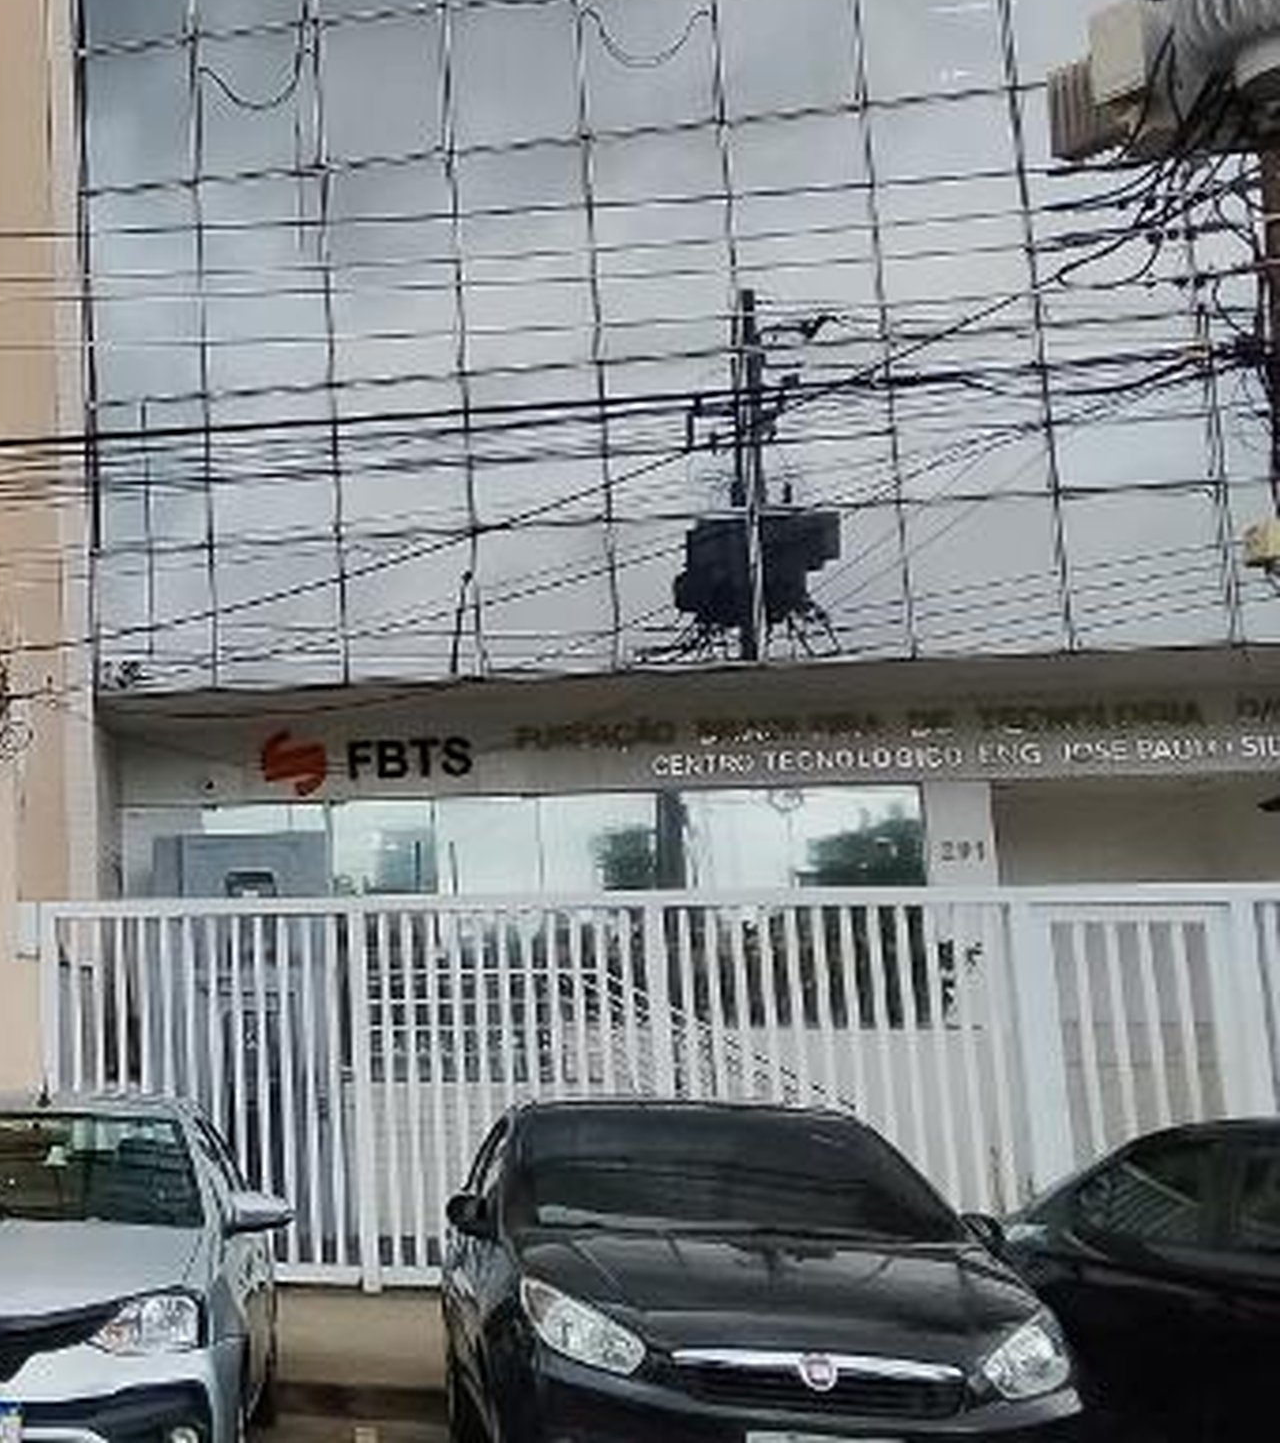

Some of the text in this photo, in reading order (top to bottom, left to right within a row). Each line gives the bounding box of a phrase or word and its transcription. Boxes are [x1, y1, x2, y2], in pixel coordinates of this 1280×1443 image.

[347, 736, 473, 779] FBTS
[651, 753, 755, 776] CENTRO
[941, 840, 985, 862] 291
